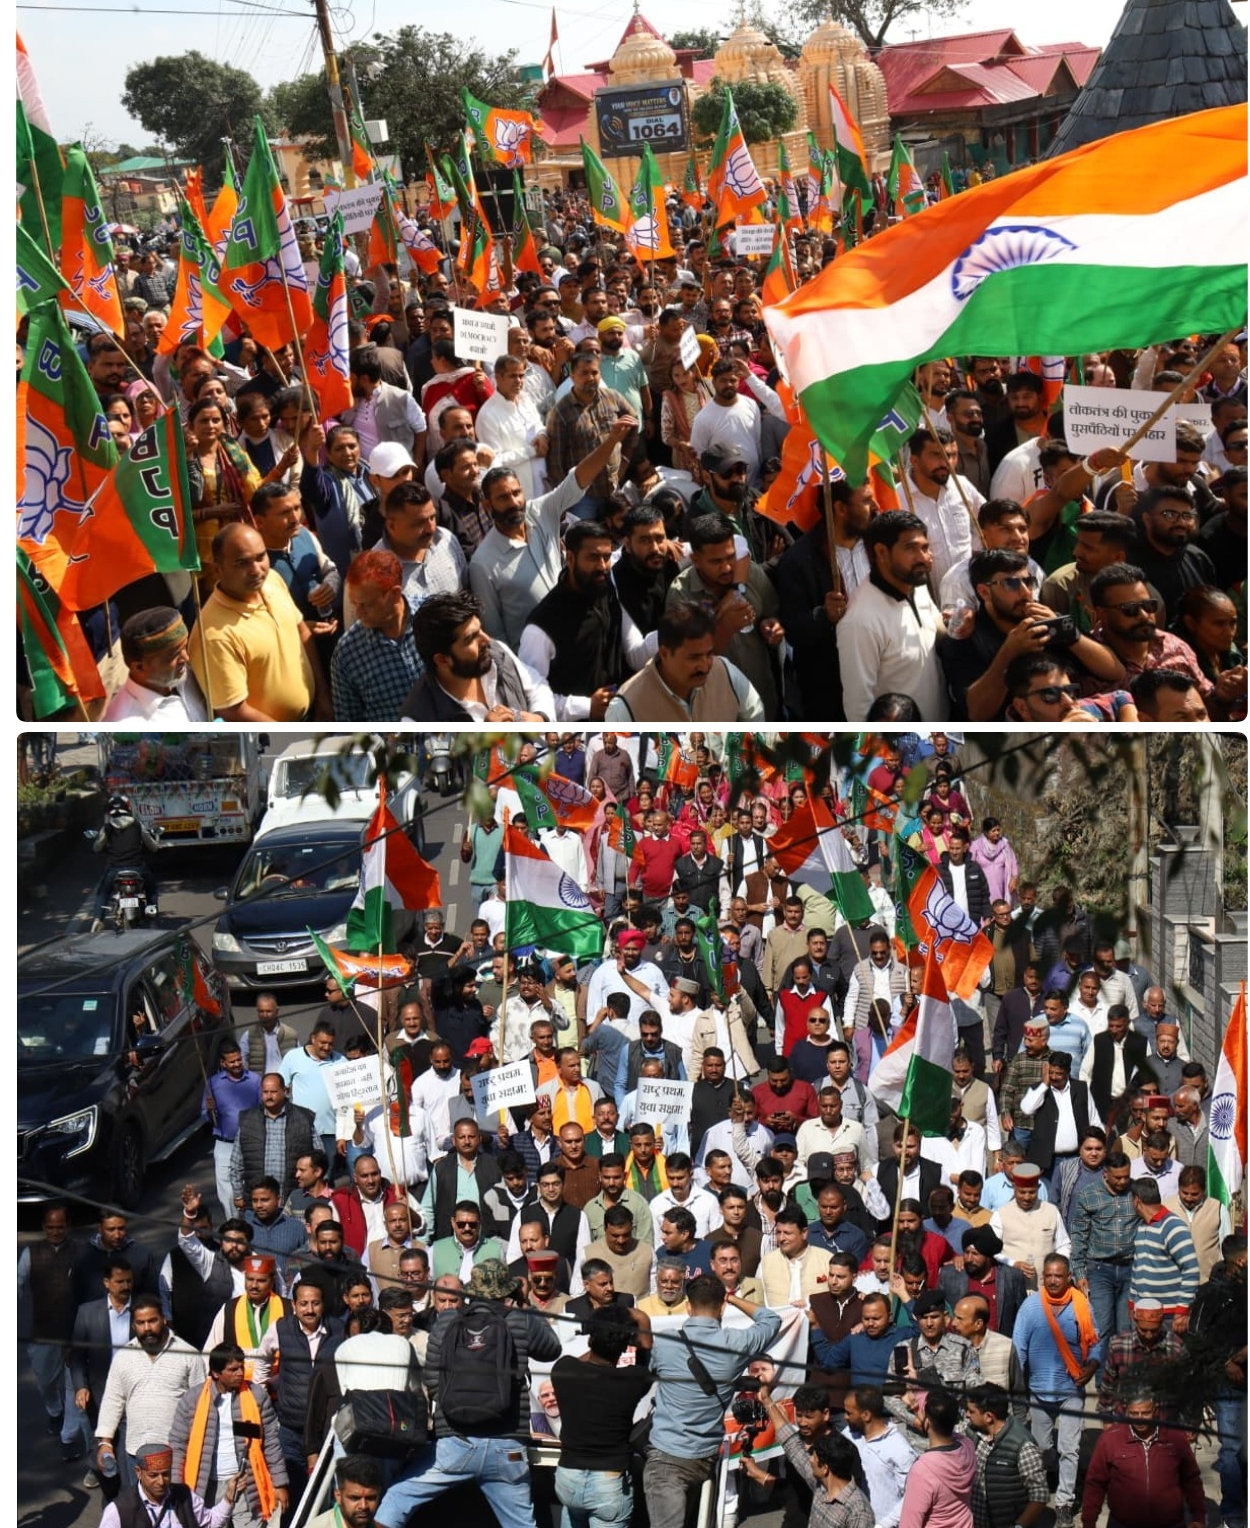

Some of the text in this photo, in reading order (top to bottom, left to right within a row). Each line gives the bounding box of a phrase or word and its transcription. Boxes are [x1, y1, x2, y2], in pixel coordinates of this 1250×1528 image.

[632, 122, 679, 139] 1064
[1069, 402, 1110, 418] लोकतंत्र
[1112, 404, 1128, 418] की
